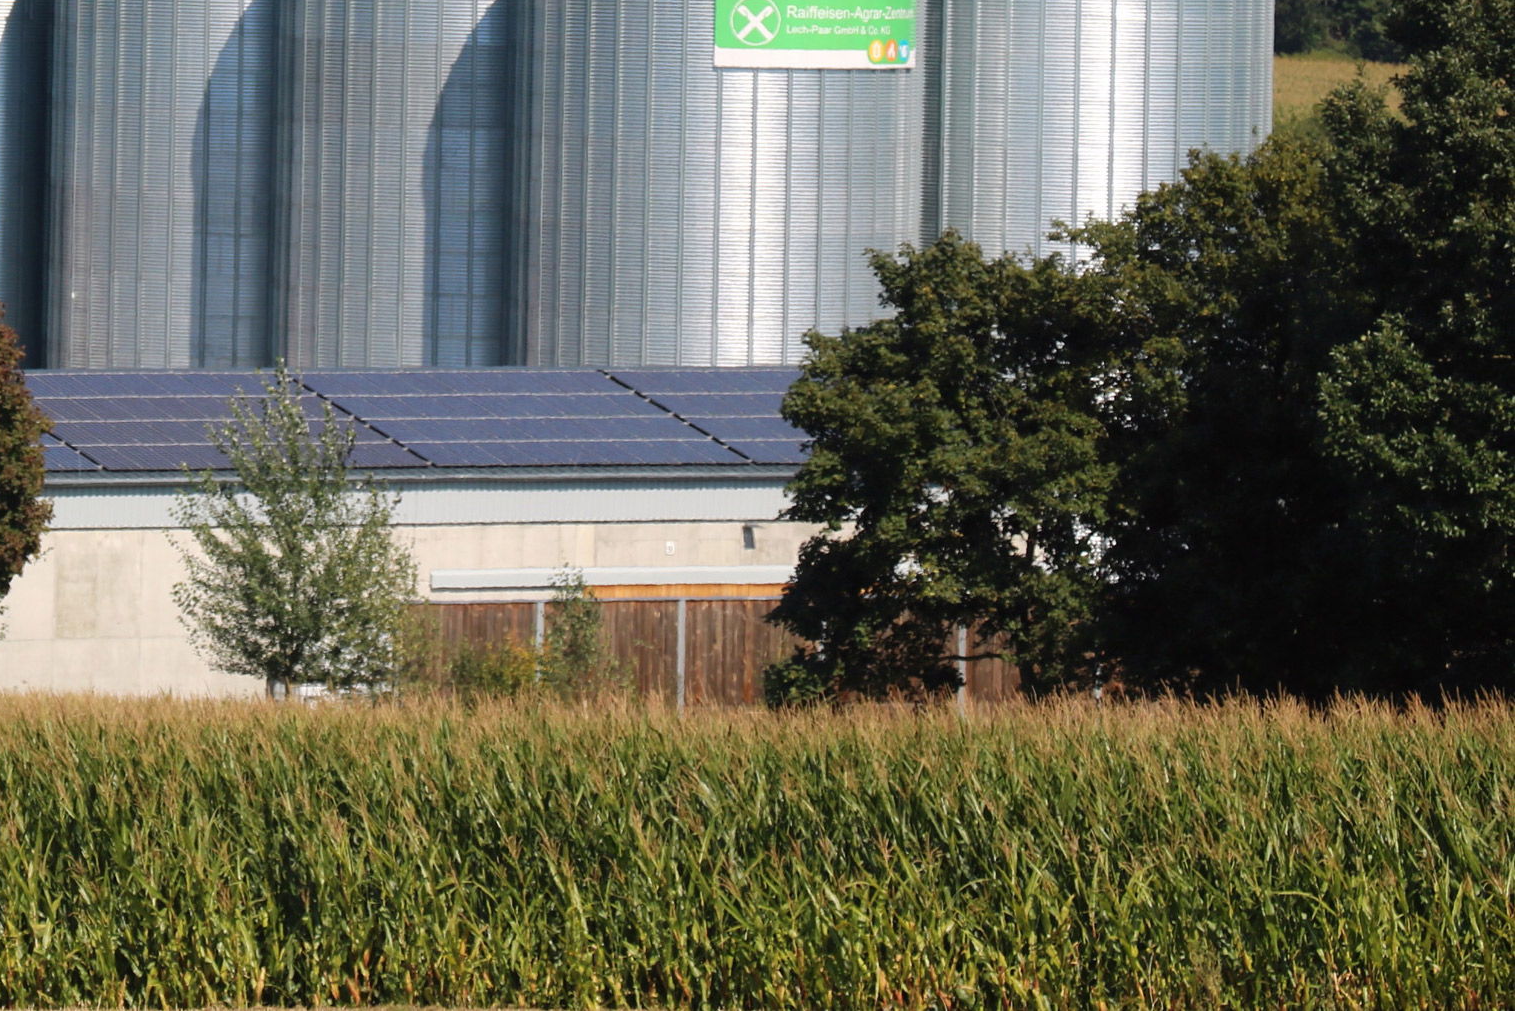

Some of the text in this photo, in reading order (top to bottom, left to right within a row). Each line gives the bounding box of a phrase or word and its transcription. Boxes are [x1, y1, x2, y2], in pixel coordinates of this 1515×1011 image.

[786, 24, 832, 35] Lech-Paar
[834, 25, 860, 35] GmbH
[861, 25, 867, 35] &
